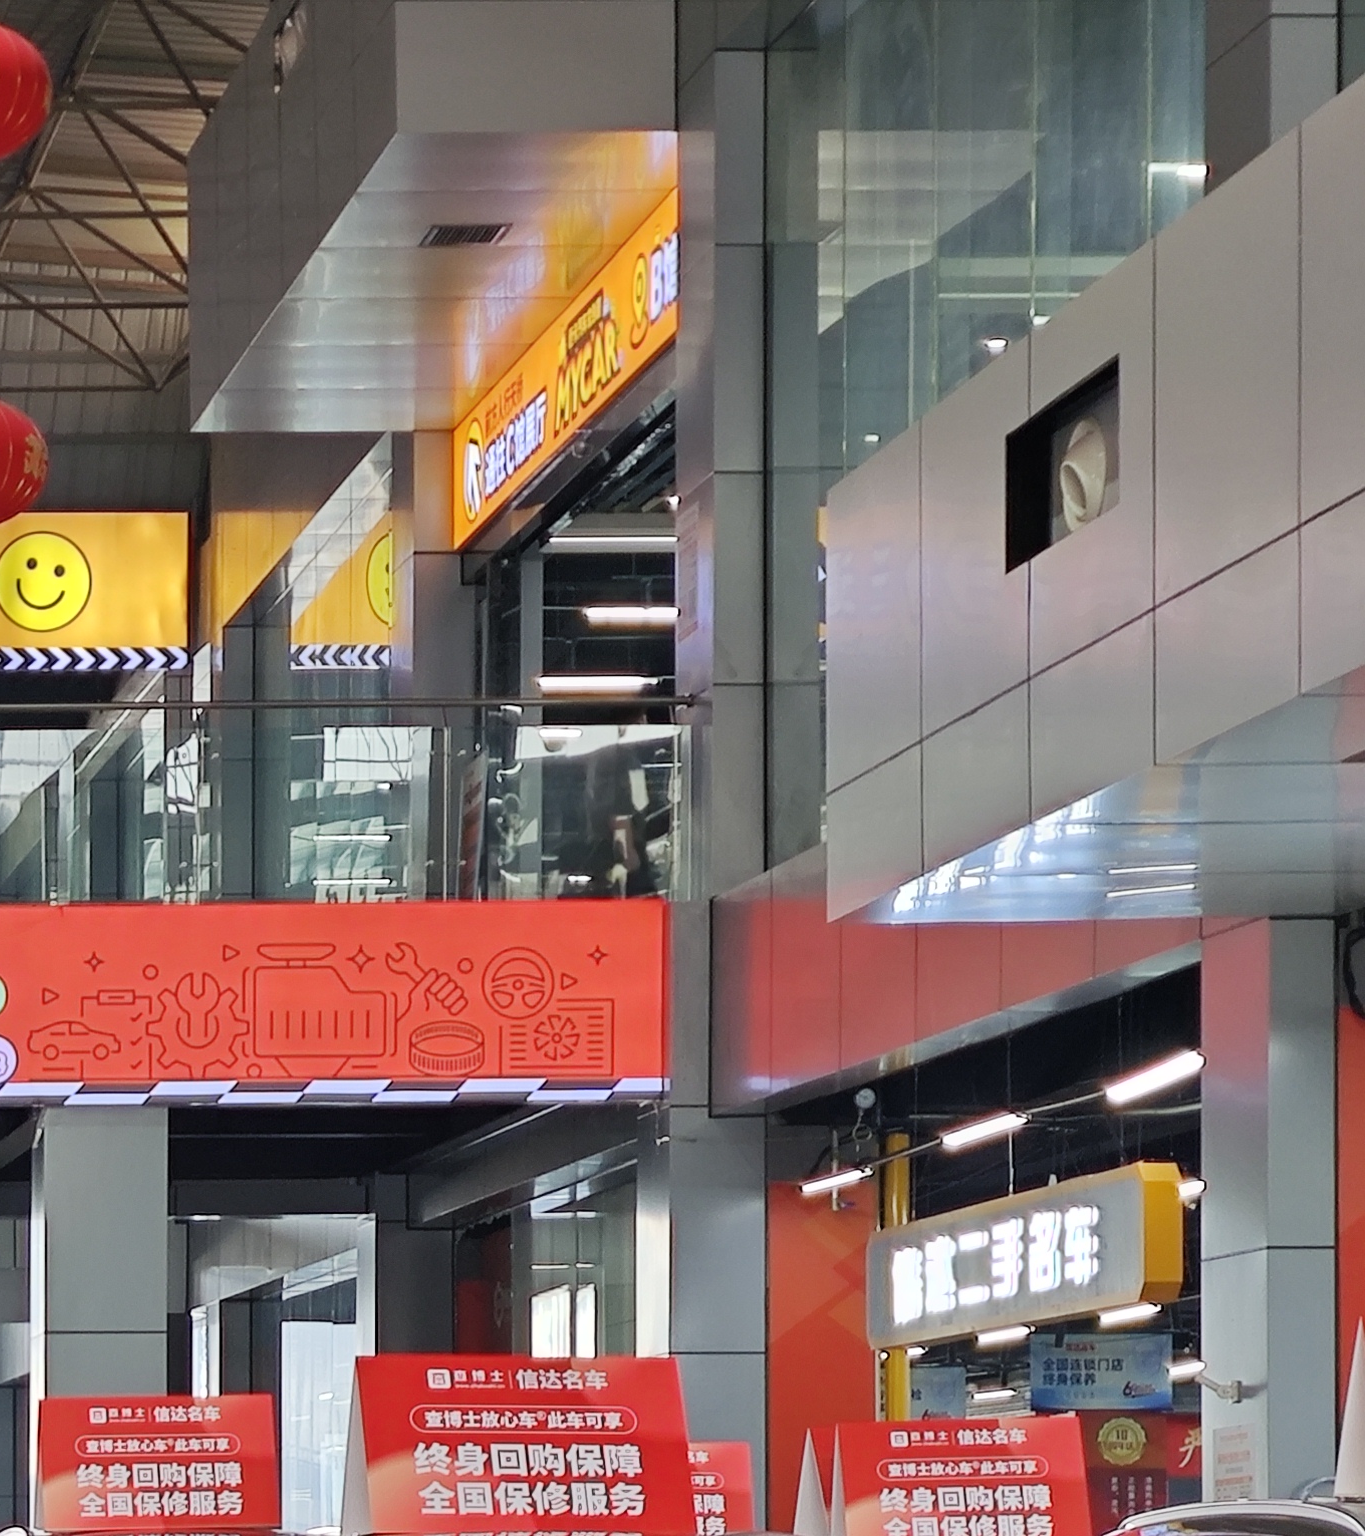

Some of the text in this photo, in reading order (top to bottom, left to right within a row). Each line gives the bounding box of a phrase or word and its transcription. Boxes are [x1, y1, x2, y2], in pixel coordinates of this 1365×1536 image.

[555, 320, 621, 440] MYCAR
[1042, 1357, 1124, 1372] 全国连锁门店
[515, 1368, 609, 1391] 信达名车
[1042, 1372, 1097, 1386] 终身保养
[153, 1405, 221, 1423] 信达名车
[957, 1427, 1028, 1446] 信达名车
[413, 1441, 644, 1478] 终身回购保障
[76, 1462, 242, 1489] 终身回购保障
[78, 1490, 244, 1518] 全国保修服务
[417, 1480, 646, 1518] 全国保修服务
[878, 1484, 1053, 1514] 终身回购保障
